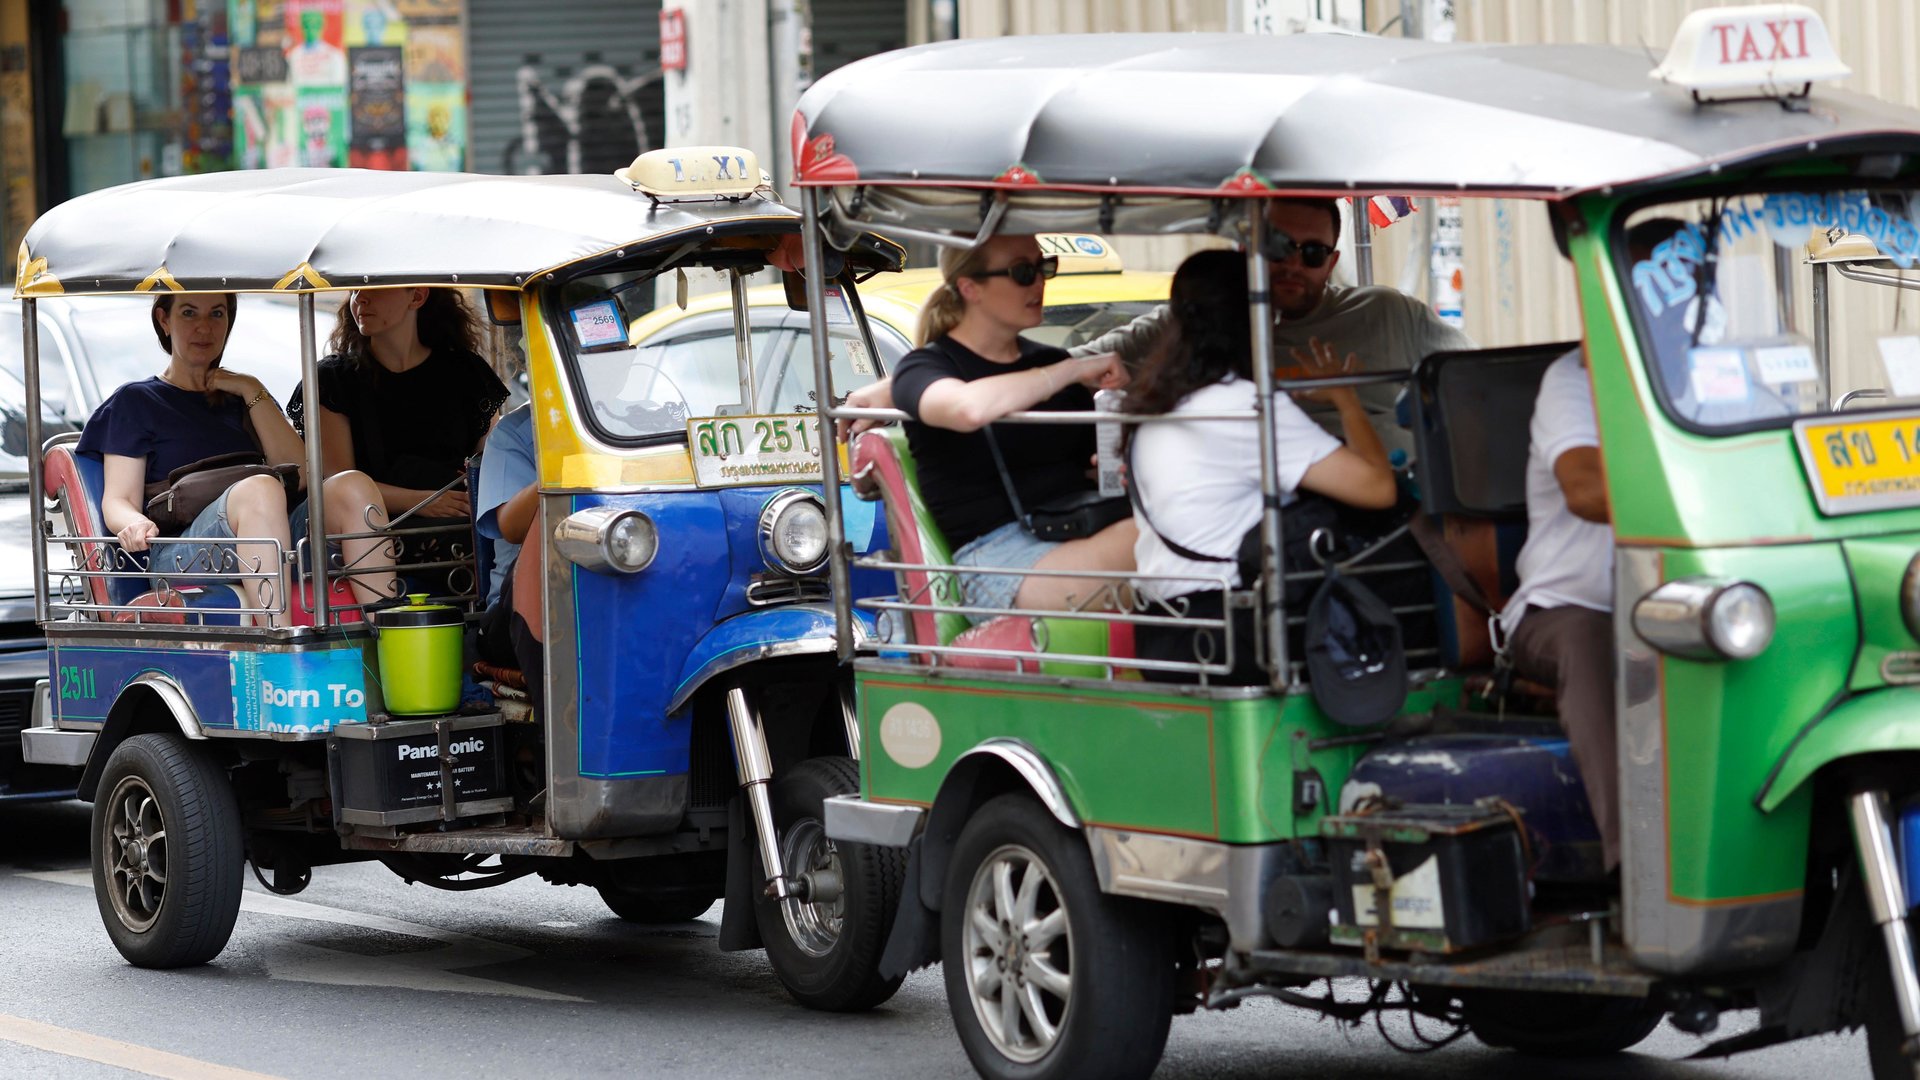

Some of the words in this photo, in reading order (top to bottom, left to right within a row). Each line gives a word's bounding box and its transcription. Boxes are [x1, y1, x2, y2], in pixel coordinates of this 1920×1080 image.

[1711, 18, 1811, 65] TAXI
[667, 155, 749, 182] TXI
[592, 315, 615, 325] 2569
[61, 666, 97, 700] 2511
[262, 681, 320, 708] Born
[327, 684, 364, 708] To
[398, 737, 484, 760] Panaonic
[411, 771, 438, 779] MAINTENANCE
